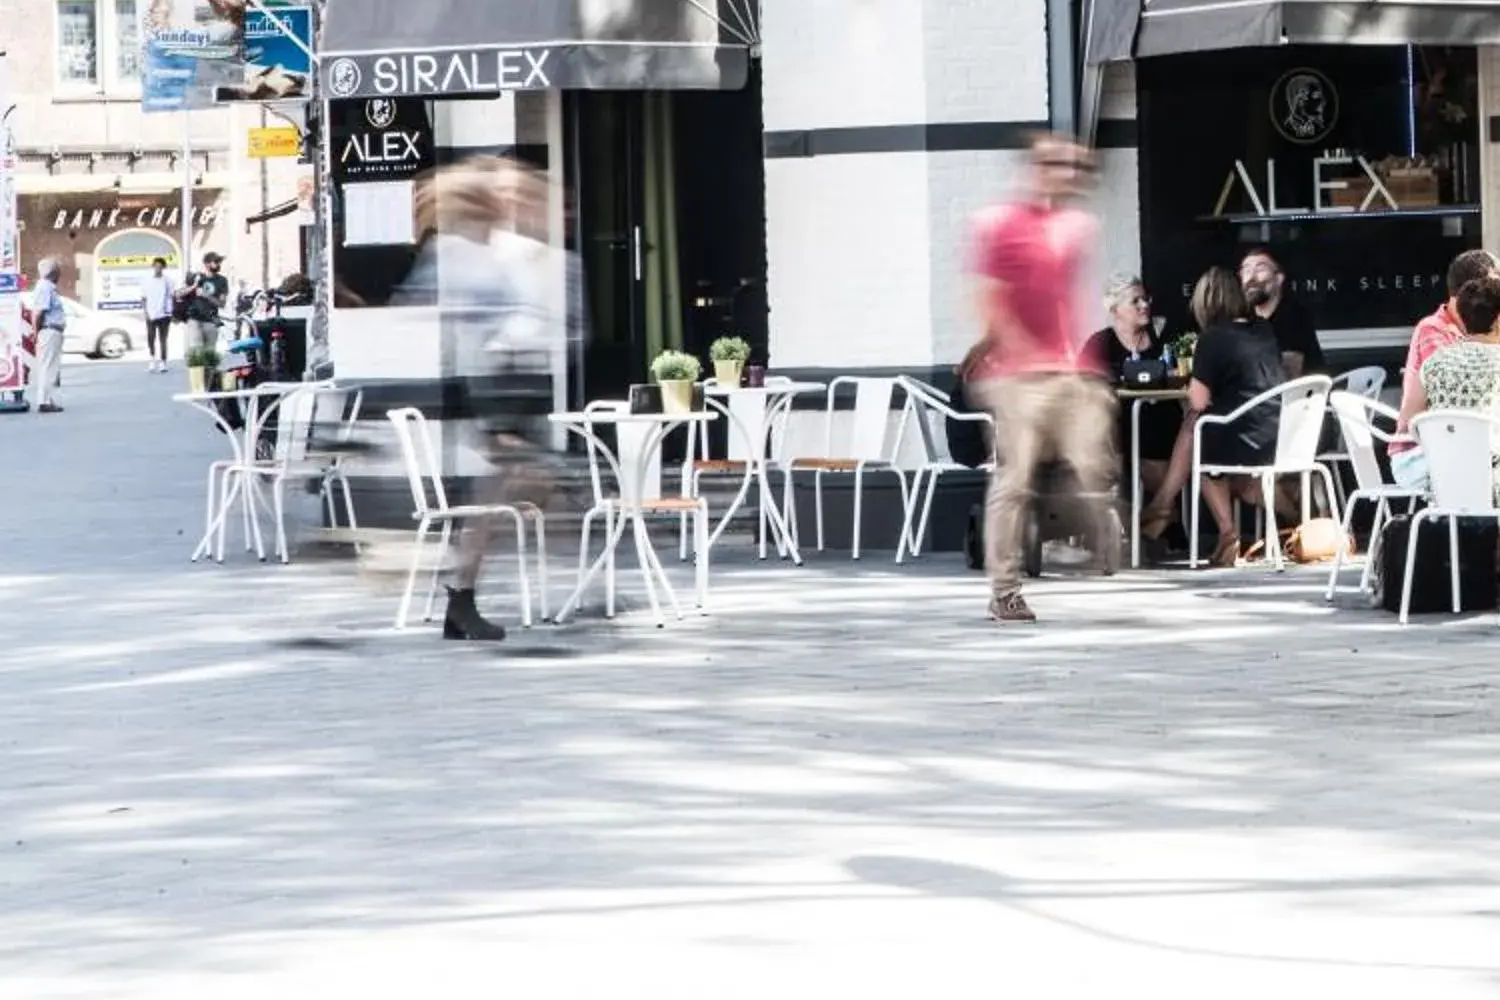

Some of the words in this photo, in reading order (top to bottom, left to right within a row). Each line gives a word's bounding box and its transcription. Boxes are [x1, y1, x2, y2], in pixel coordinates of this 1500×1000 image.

[373, 49, 551, 94] SIRALEX
[340, 130, 421, 163] ALEX
[1213, 154, 1400, 217] ALEX
[1292, 280, 1337, 292] INK
[1359, 274, 1440, 290] SLEEP
